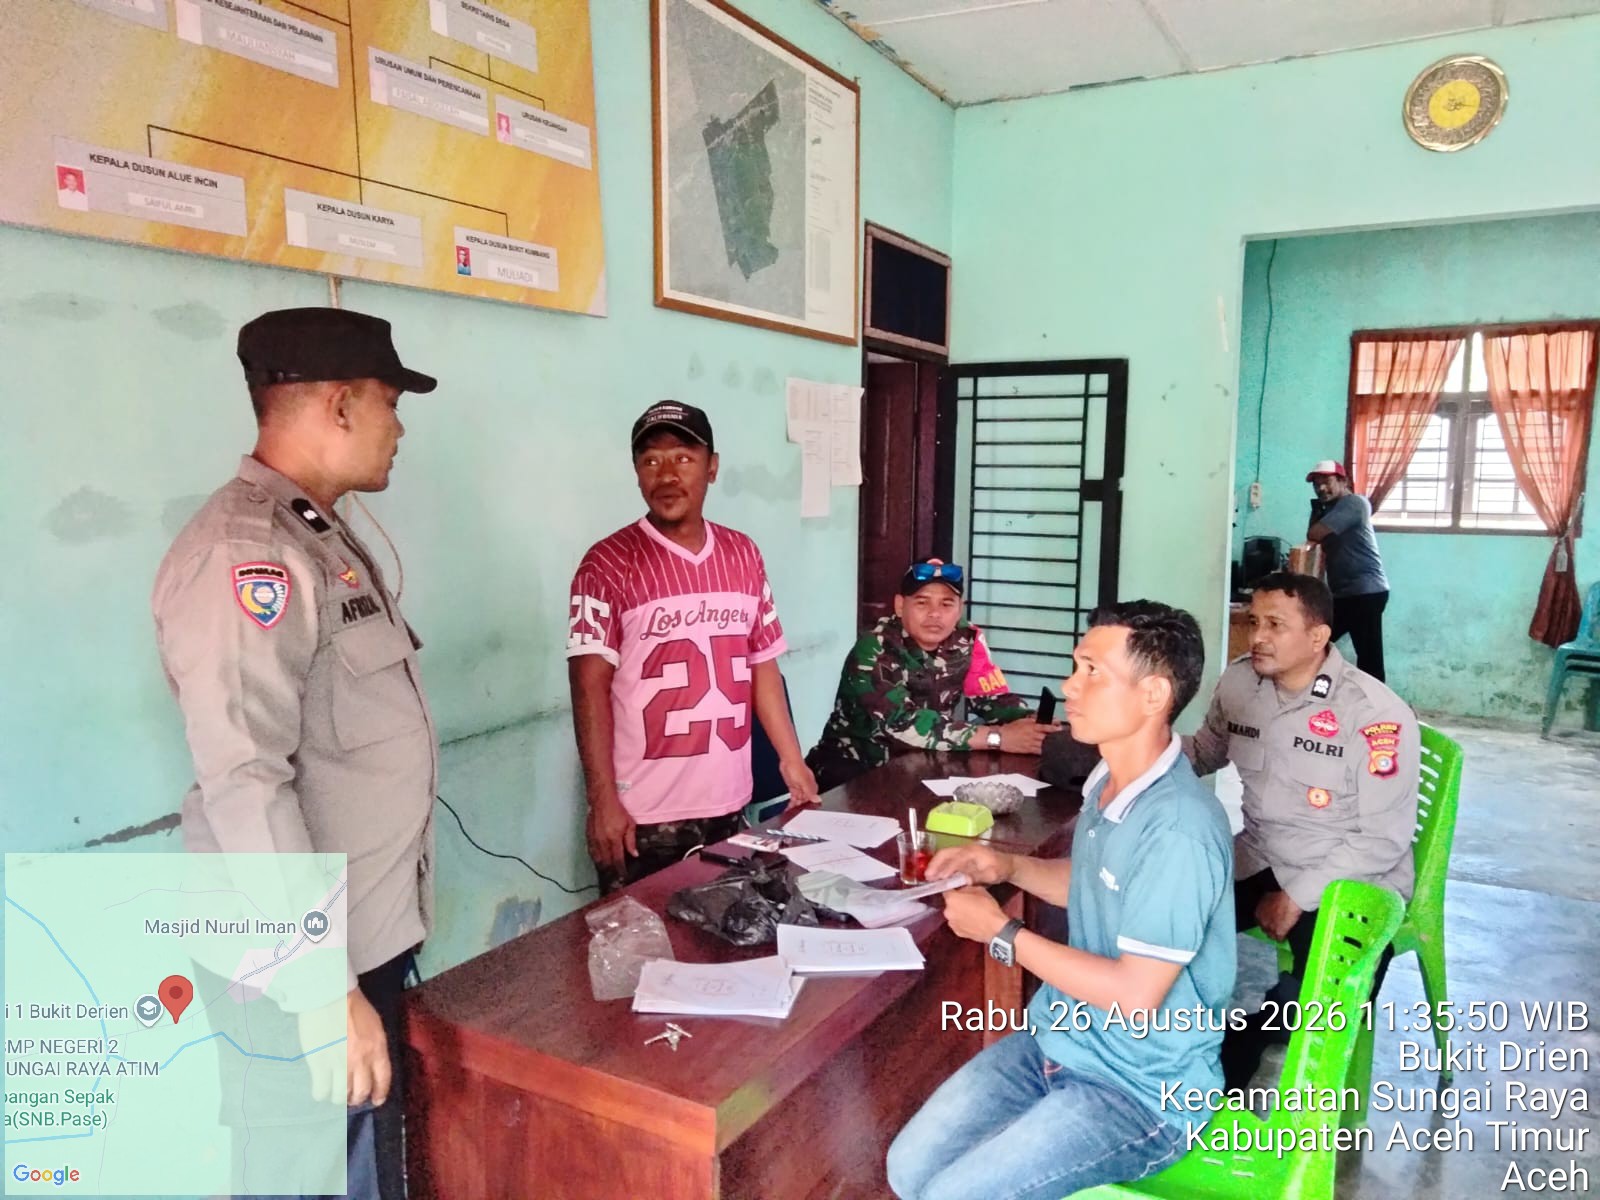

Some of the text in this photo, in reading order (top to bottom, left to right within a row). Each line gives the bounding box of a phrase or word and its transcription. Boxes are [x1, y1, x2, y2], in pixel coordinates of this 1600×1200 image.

[374, 56, 402, 72] URUSAN
[424, 73, 437, 84] DAN
[89, 153, 218, 188] KEPALA DUSUN ALUE INCIN
[316, 203, 395, 226] KEPALA DUSUN KARYA
[466, 235, 488, 246] KEPALA
[489, 240, 507, 250] DUSUN
[497, 266, 533, 282] MULIADI
[640, 607, 682, 640] Los
[641, 634, 752, 760] 25
[1293, 736, 1345, 758] POLRI
